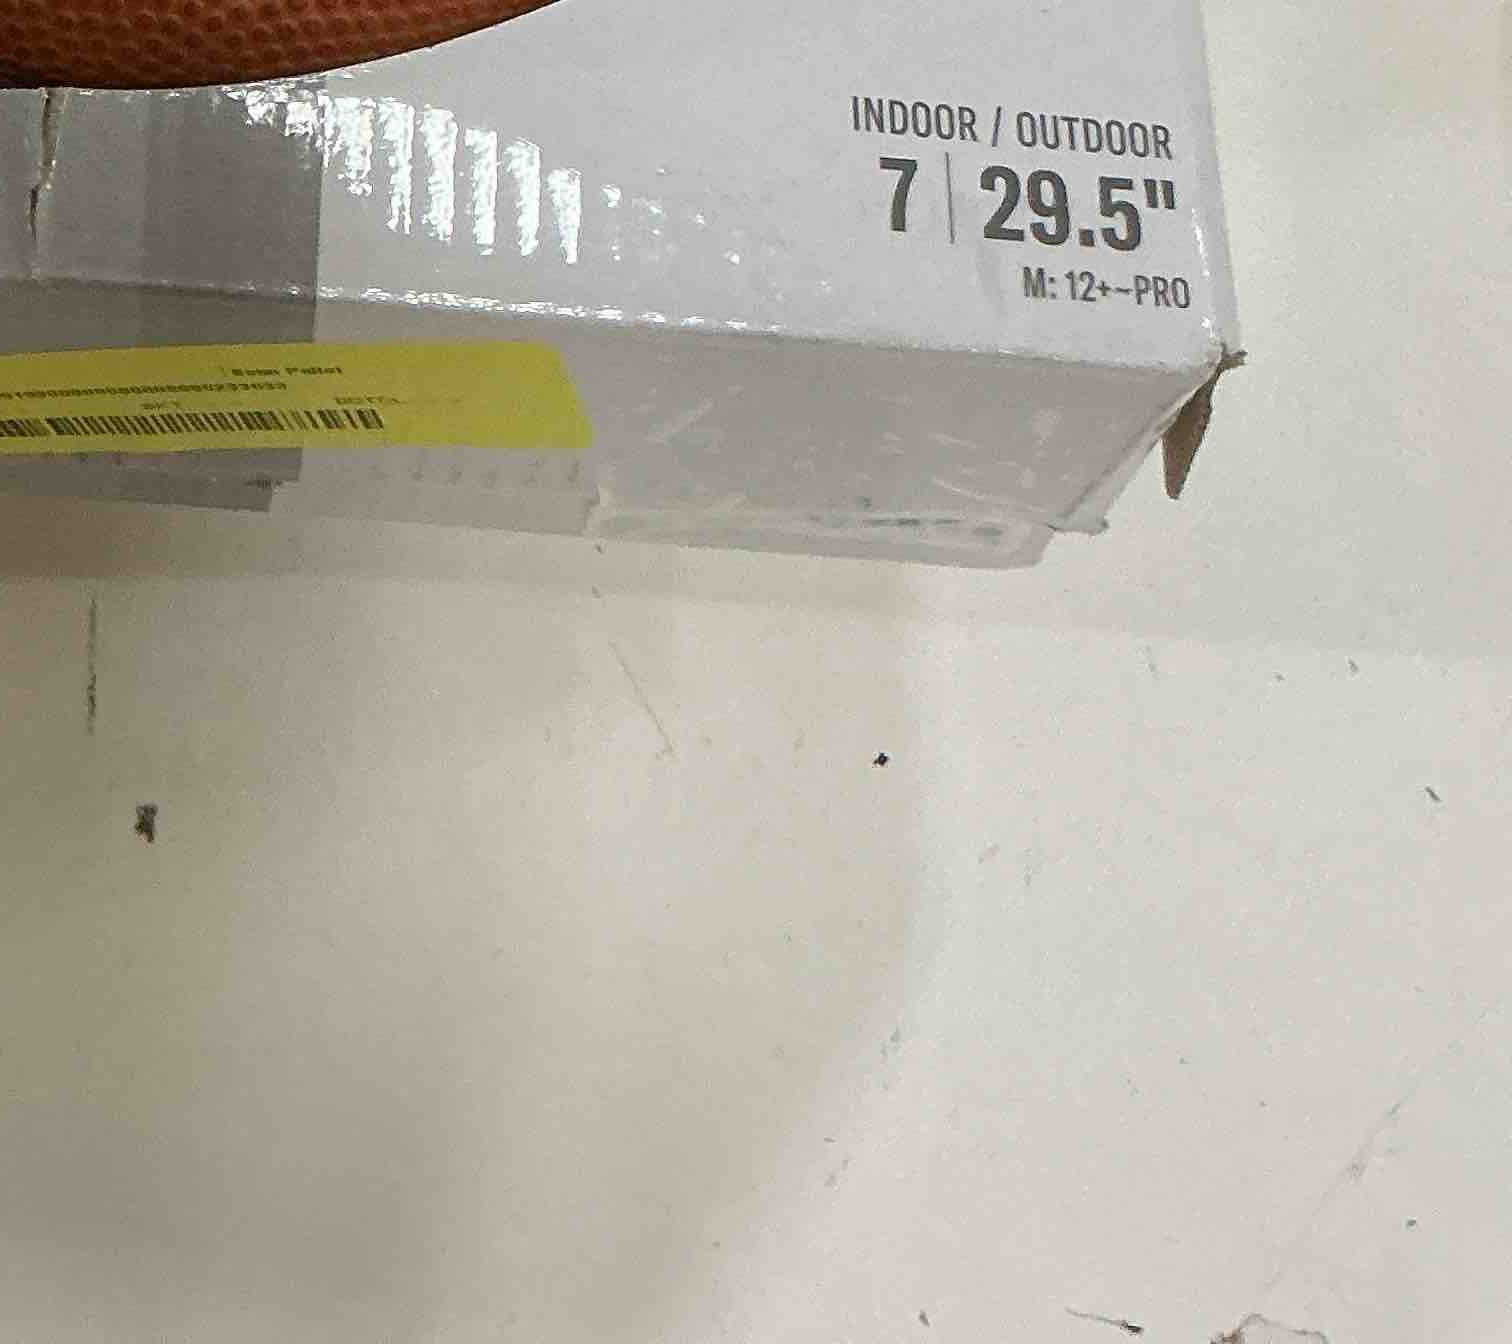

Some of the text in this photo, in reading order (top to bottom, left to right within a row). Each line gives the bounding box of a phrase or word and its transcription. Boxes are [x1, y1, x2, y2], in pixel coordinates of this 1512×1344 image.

[850, 95, 979, 142] INDOOR
[1016, 111, 1174, 160] OUTDOOR
[878, 156, 1176, 252] 7 29.5"
[1023, 266, 1057, 300] M:
